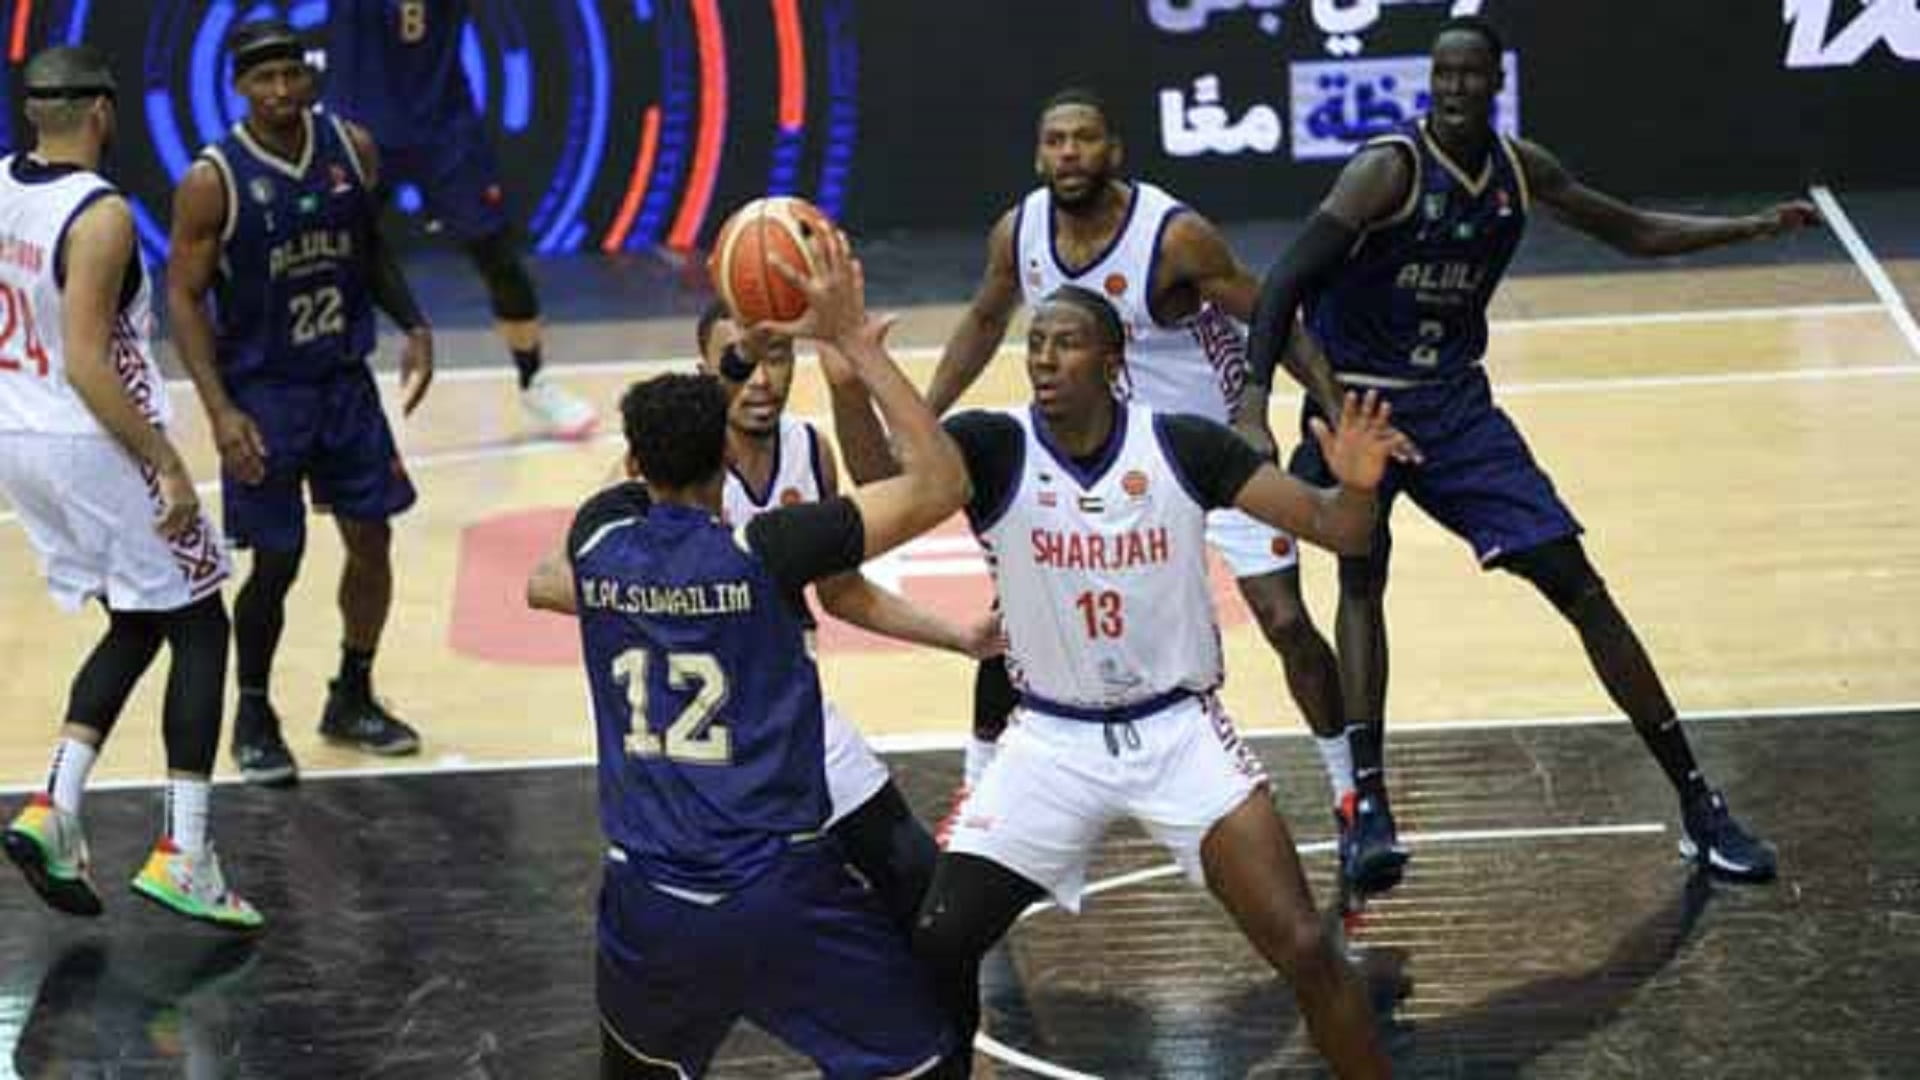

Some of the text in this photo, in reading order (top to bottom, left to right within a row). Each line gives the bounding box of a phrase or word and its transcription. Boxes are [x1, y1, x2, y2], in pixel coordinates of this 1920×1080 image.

[289, 286, 343, 343] 22
[1409, 320, 1443, 367] 2
[1030, 526, 1170, 571] SHARJAH
[1075, 590, 1125, 640] 13
[609, 648, 736, 765] 12
